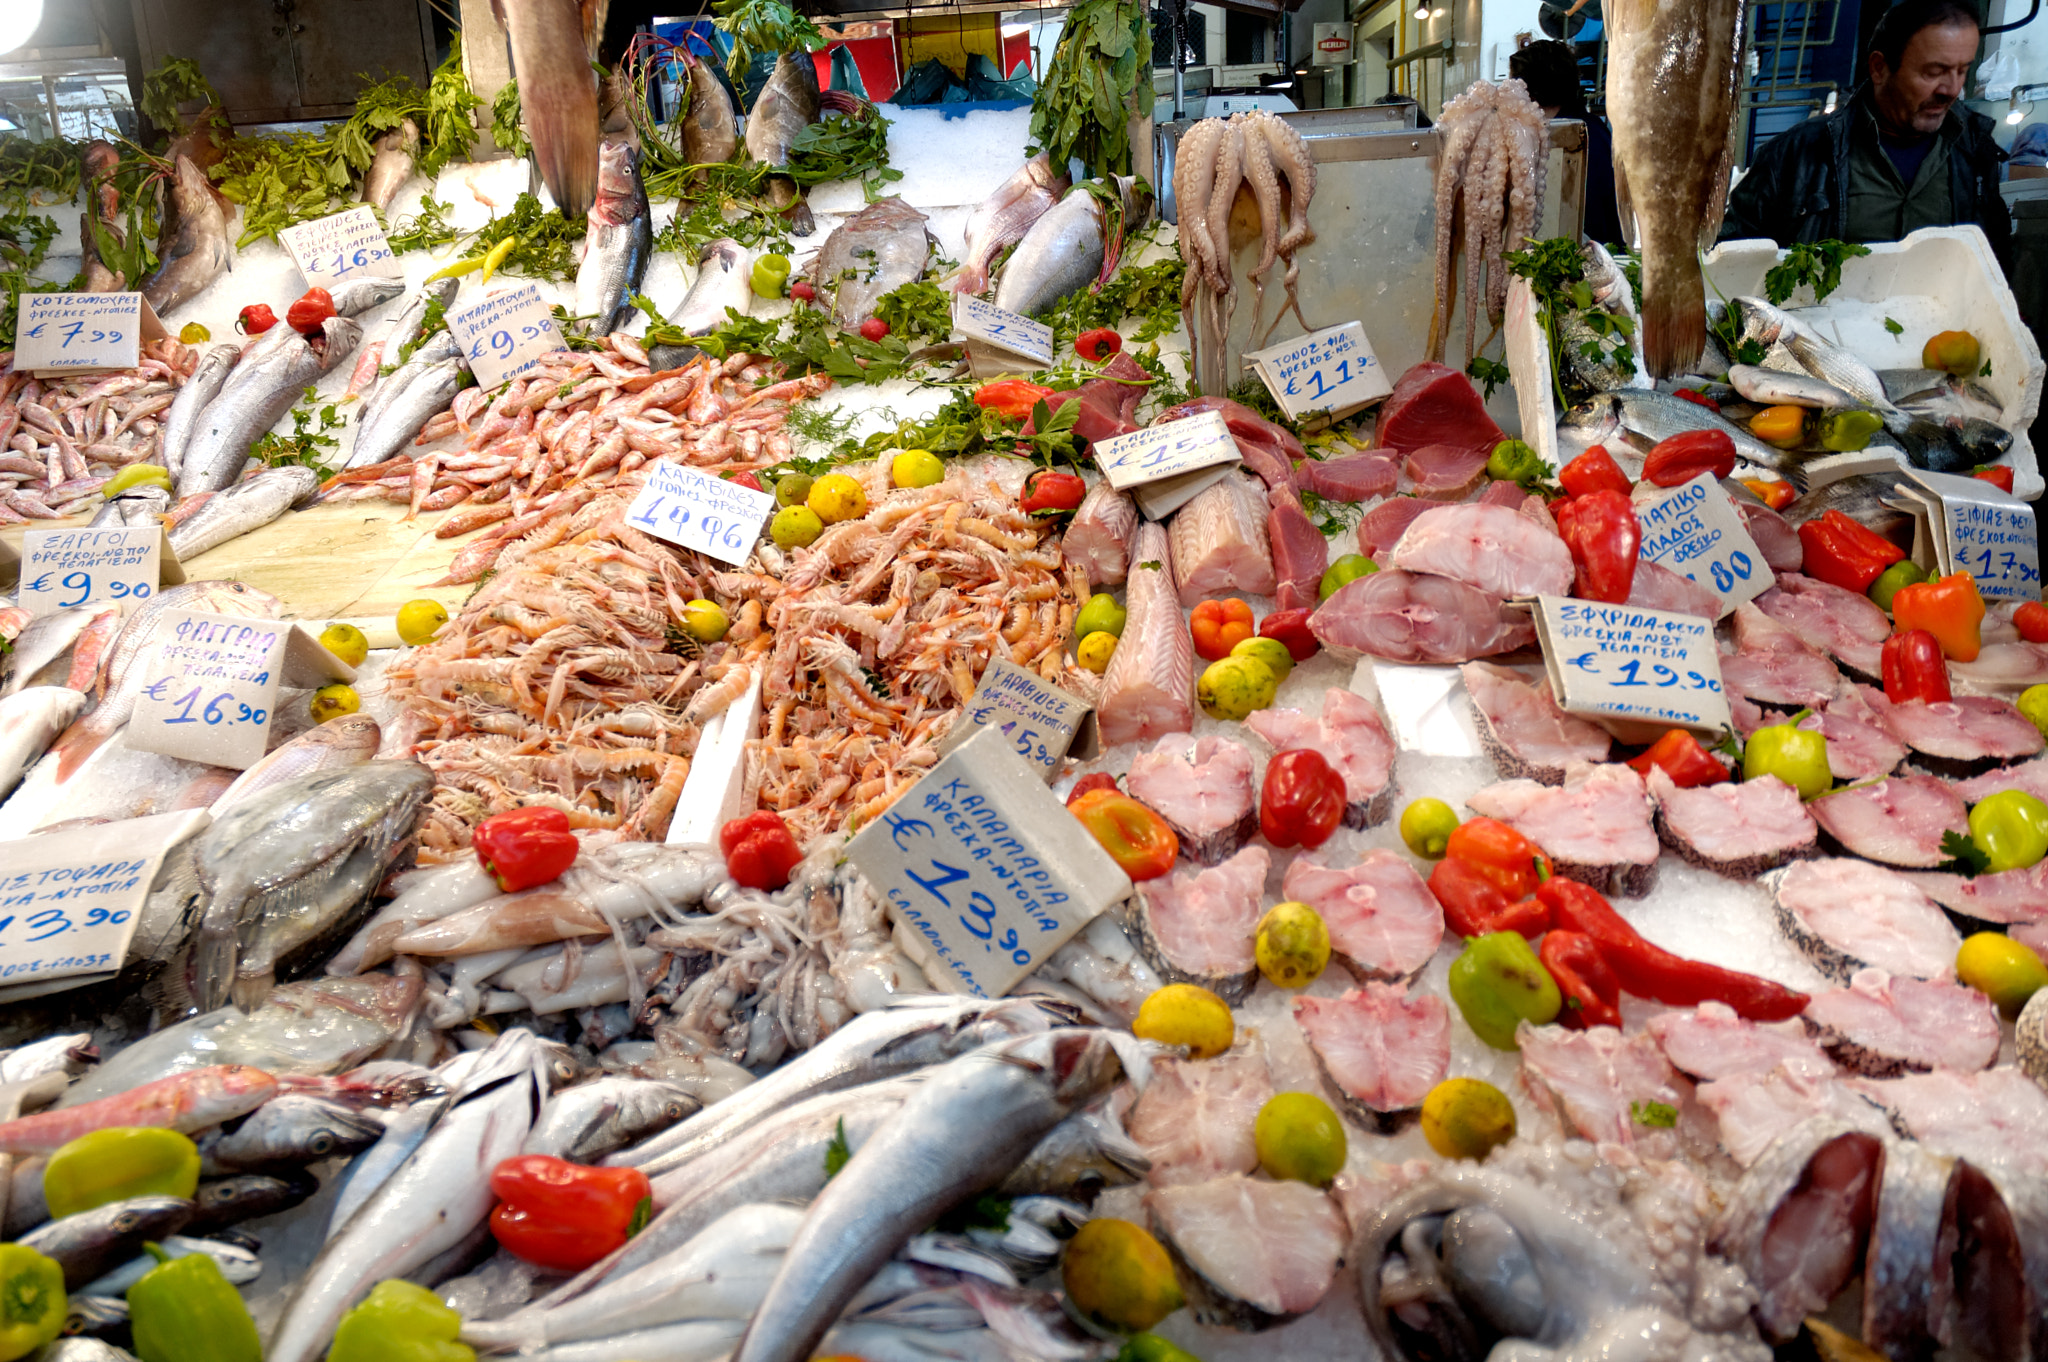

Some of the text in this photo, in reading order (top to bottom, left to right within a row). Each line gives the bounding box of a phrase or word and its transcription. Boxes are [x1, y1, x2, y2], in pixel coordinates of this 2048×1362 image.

[1320, 41, 1348, 49] BERLIN
[58, 320, 123, 349] 7.99
[658, 462, 760, 511] ΚΑΡΑΒΙΔΕΣ
[43, 531, 129, 549] ΣΑΡΓΟΙ
[942, 777, 1070, 905] ΚΑΛΑΜΑΡΙΑ
[904, 858, 1032, 967] 13.90
